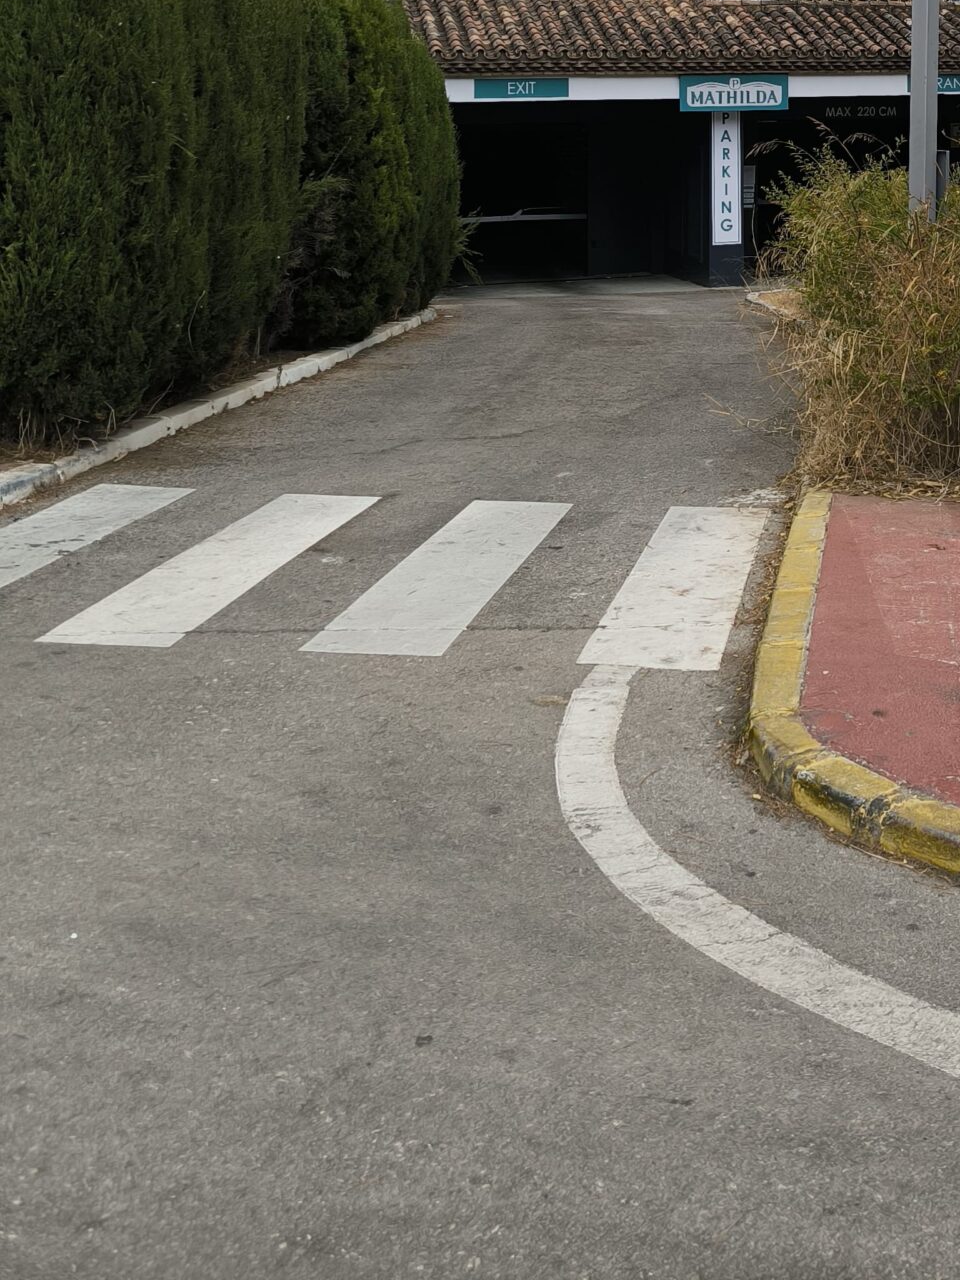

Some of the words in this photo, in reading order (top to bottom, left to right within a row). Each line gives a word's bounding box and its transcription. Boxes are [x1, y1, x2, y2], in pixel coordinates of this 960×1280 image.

[506, 81, 537, 95] EXIT
[690, 89, 778, 105] MATHILDA
[825, 106, 852, 117] MAX
[857, 106, 876, 117] 220
[878, 106, 897, 117] CM
[720, 112, 733, 232] PARKING
